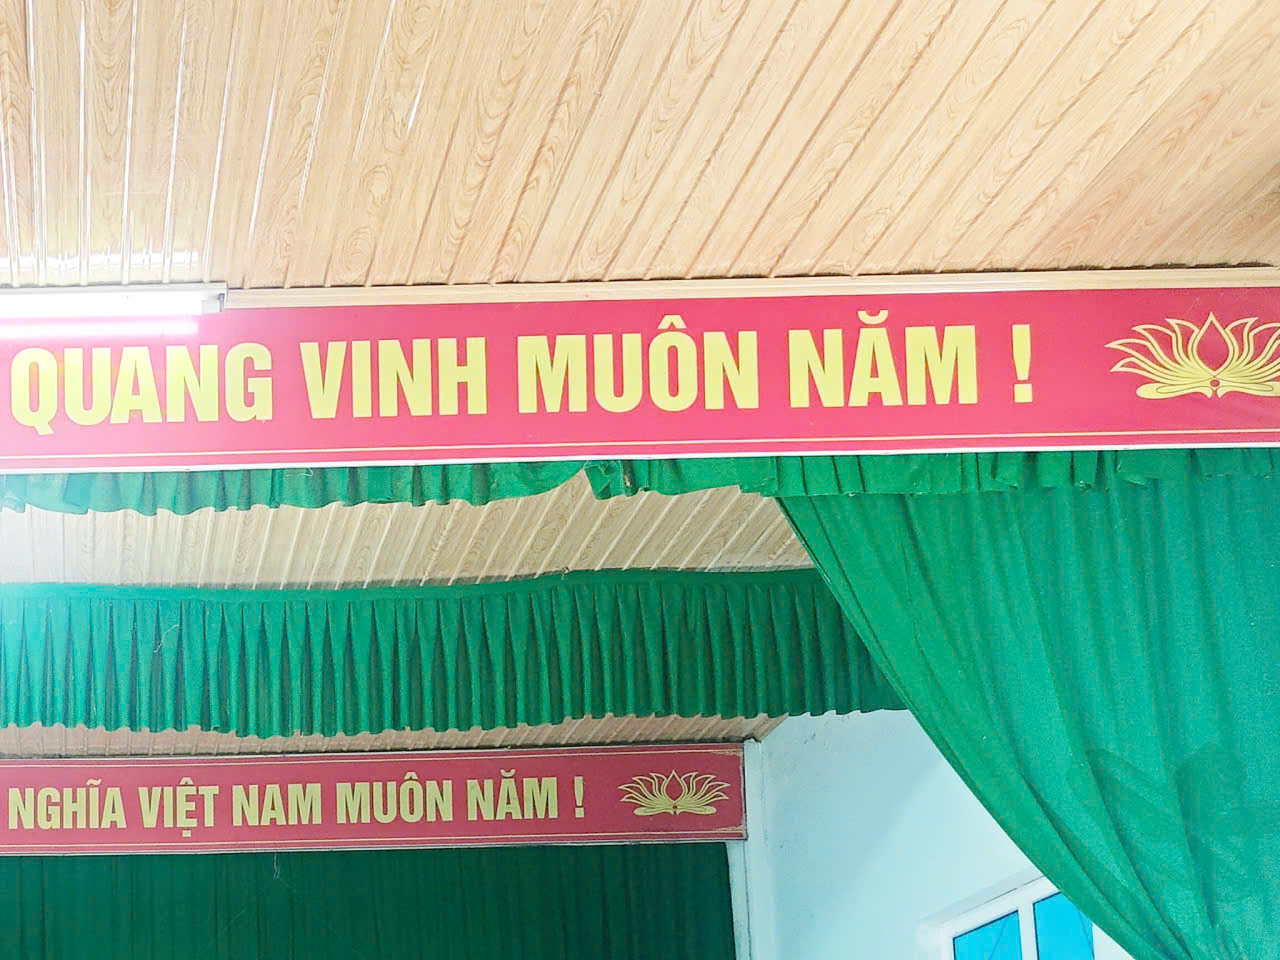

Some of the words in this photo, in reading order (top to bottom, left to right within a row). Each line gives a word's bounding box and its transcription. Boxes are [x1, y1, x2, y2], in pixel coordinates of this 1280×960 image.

[10, 344, 273, 435] QUANG
[300, 336, 489, 420] VINH
[519, 314, 760, 414] MUÔN
[788, 310, 978, 408] NĂM
[1012, 325, 1033, 404] !
[8, 779, 127, 830] NGHĨA
[138, 777, 221, 837] VIỆT
[232, 783, 322, 827] NAM
[336, 772, 453, 825] MUÔN
[466, 769, 559, 822] NĂM
[574, 776, 585, 818] !
